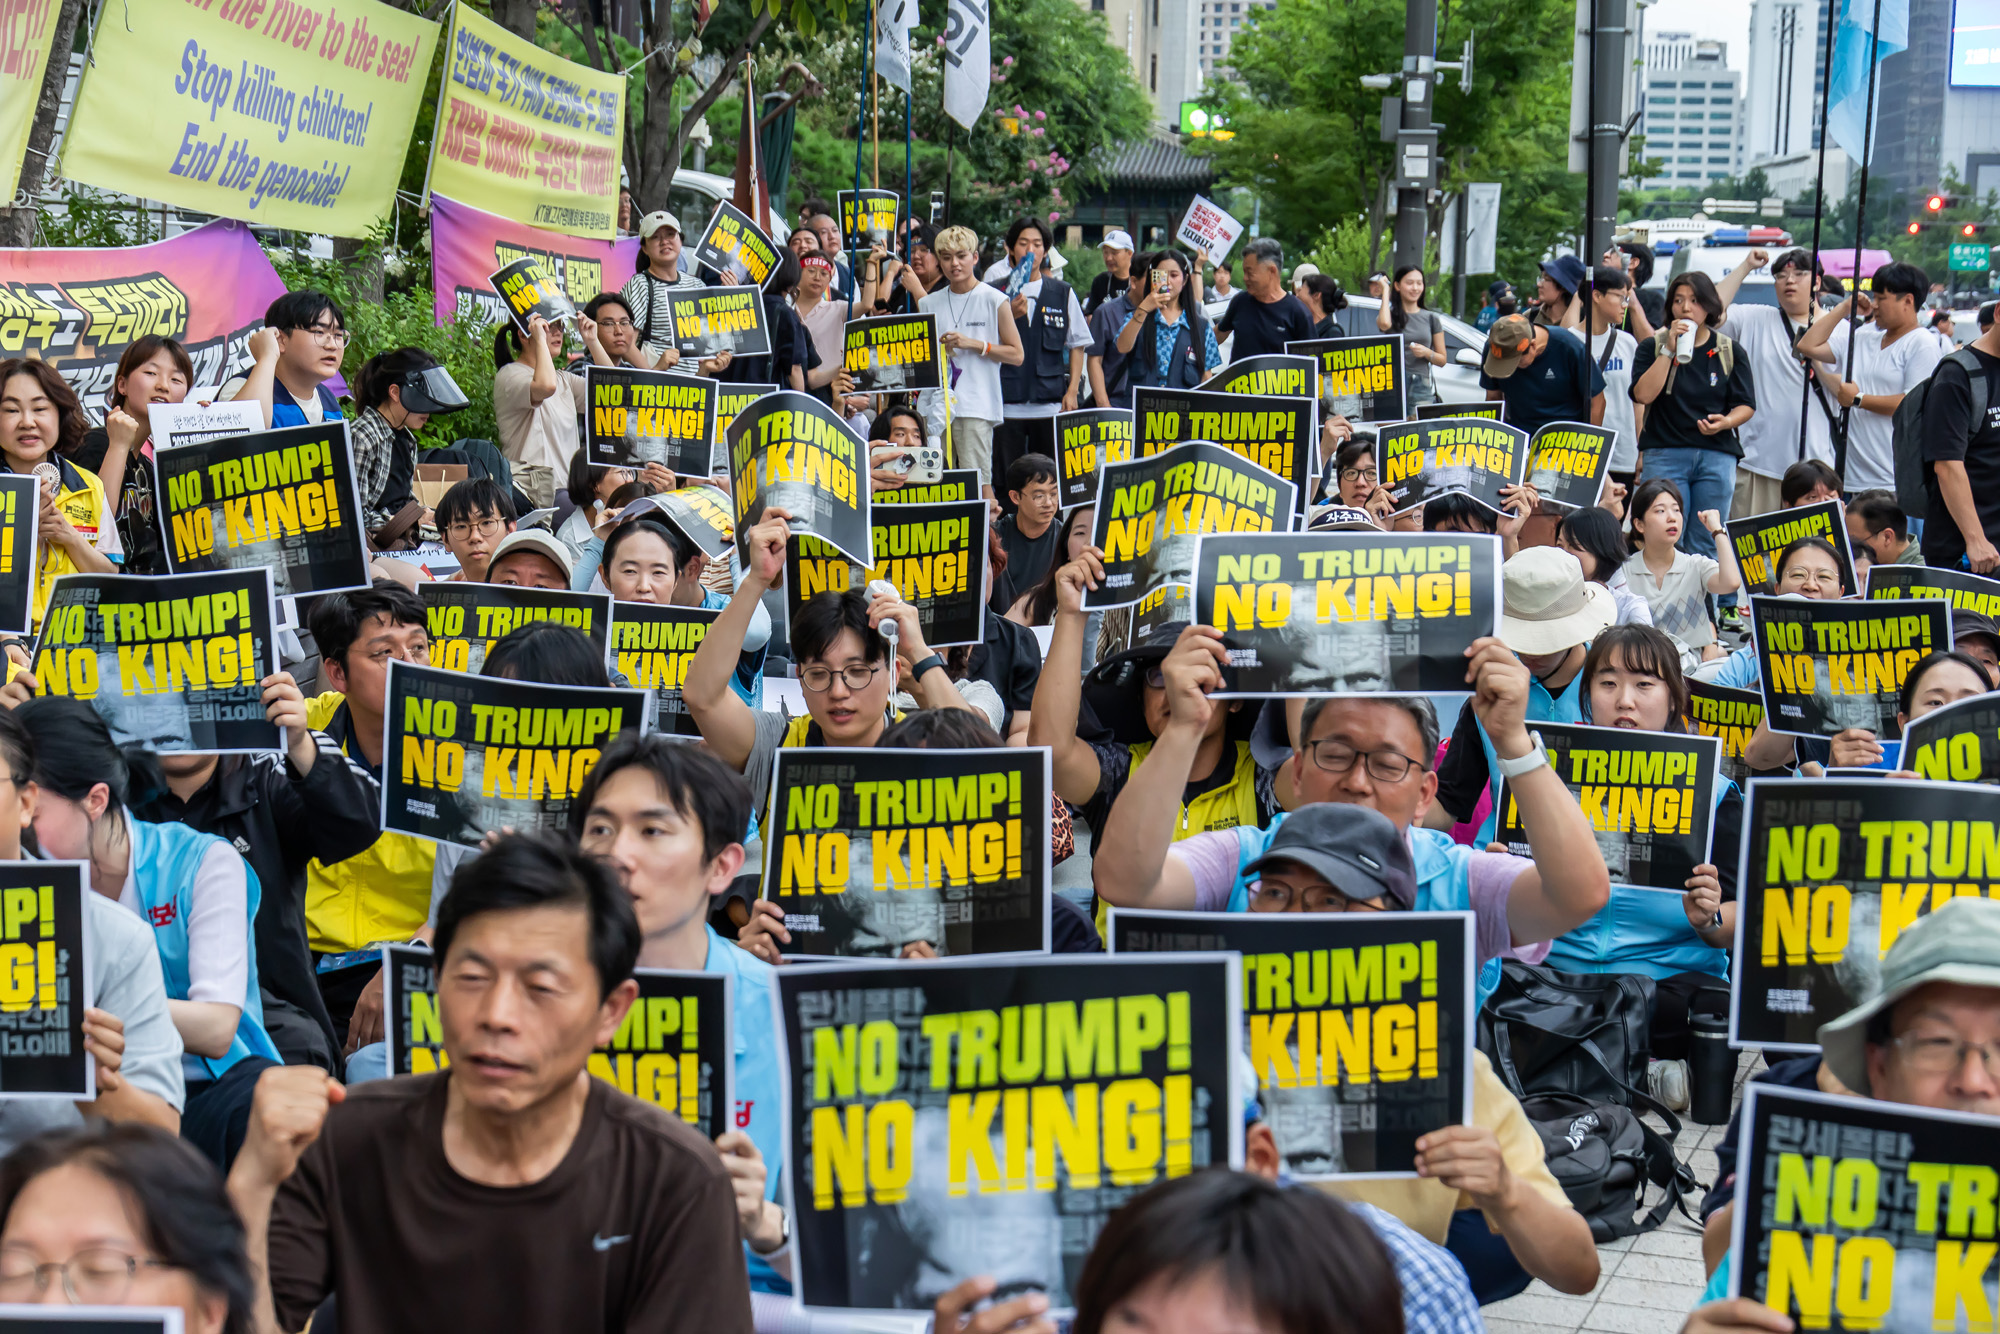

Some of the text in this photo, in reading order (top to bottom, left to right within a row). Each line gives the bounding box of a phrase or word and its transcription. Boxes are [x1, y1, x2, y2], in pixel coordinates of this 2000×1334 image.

[262, 0, 323, 51] river
[319, 7, 345, 59] to
[344, 16, 380, 71] the
[377, 34, 420, 84] sea!
[175, 39, 373, 147] Stop killing children!
[453, 27, 496, 95] 헌법과
[497, 51, 522, 107] 국가
[520, 64, 546, 116] 위에
[585, 89, 597, 131] 두
[169, 122, 351, 209] End the genocide!
[440, 97, 487, 166] 재벌
[485, 114, 535, 180] 해체!!
[534, 132, 581, 191] 국정원
[845, 200, 863, 214] NO
[846, 213, 868, 233] NO
[709, 227, 768, 284] NO KING!
[719, 214, 776, 268] NO TRUMP!
[502, 269, 529, 295] NO
[510, 281, 544, 314] NO
[674, 293, 753, 316] NO TRUMP!
[66, 277, 187, 347] 특검하라!
[677, 308, 757, 338] NO KING!
[848, 321, 928, 348] NO TRUMP!
[846, 338, 930, 371] NO KING!
[1323, 344, 1392, 371] TRUMP!
[596, 385, 706, 409] NO TRUMP!
[1225, 369, 1305, 394] TRUMP!
[1332, 364, 1393, 396] KING!
[595, 408, 627, 437] NO
[637, 408, 704, 440] KING!
[734, 429, 751, 476] NO
[758, 410, 856, 469] TRUMP!
[1064, 421, 1132, 449] NO TRU
[1146, 412, 1295, 440] NO TRUMP!
[1388, 427, 1514, 457] NO TRUMP!
[1536, 432, 1604, 454] TRUMP!
[168, 440, 333, 511] NO TRUMP!
[736, 458, 757, 522] NO
[766, 442, 857, 509] KING!
[1065, 444, 1096, 479] NO
[1387, 451, 1424, 483] NO
[1436, 444, 1512, 478] KING!
[1532, 448, 1599, 478] KING!
[1111, 462, 1276, 518] NO TRUMP!
[172, 479, 341, 562] NO KING!
[872, 517, 969, 557] RUMP!
[1104, 494, 1272, 563] NO KING!
[1736, 512, 1832, 557] NO TRUMP!
[800, 550, 968, 601] NO KING!
[1218, 547, 1469, 582] NO TRUMP!
[1742, 555, 1767, 585] NO
[44, 589, 251, 646] NO TRUMP!
[427, 606, 464, 640] NO
[1213, 573, 1471, 632] NO KING!
[1906, 586, 2000, 623] TRUMP
[1766, 615, 1931, 651] NO TRUMP!
[35, 632, 255, 700] NO KING!
[618, 652, 696, 689] KING
[1770, 654, 1815, 694] NO
[405, 697, 622, 745] NO TRUMP!
[1691, 695, 1765, 725] TRUM
[1699, 723, 1752, 757] KIN
[1914, 732, 1981, 781] NO
[403, 736, 601, 800] NO KING
[1570, 750, 1697, 788] TRUMP!
[786, 771, 1021, 830] NO TRUMP!
[1580, 786, 1694, 834] KING!
[780, 819, 1021, 896] NO KING!
[1766, 821, 2000, 883] NO TRUM
[1762, 885, 1852, 966] NO
[1243, 941, 1437, 1009] TRUMP!
[411, 992, 698, 1054] N MP!
[1250, 1001, 1438, 1089] KING!
[814, 992, 1191, 1104] NO TRUMP!
[587, 1054, 698, 1123] NG!
[812, 1076, 1191, 1209] NO KING!
[1772, 1154, 1879, 1232] NO
[1765, 1231, 1895, 1329] NO
